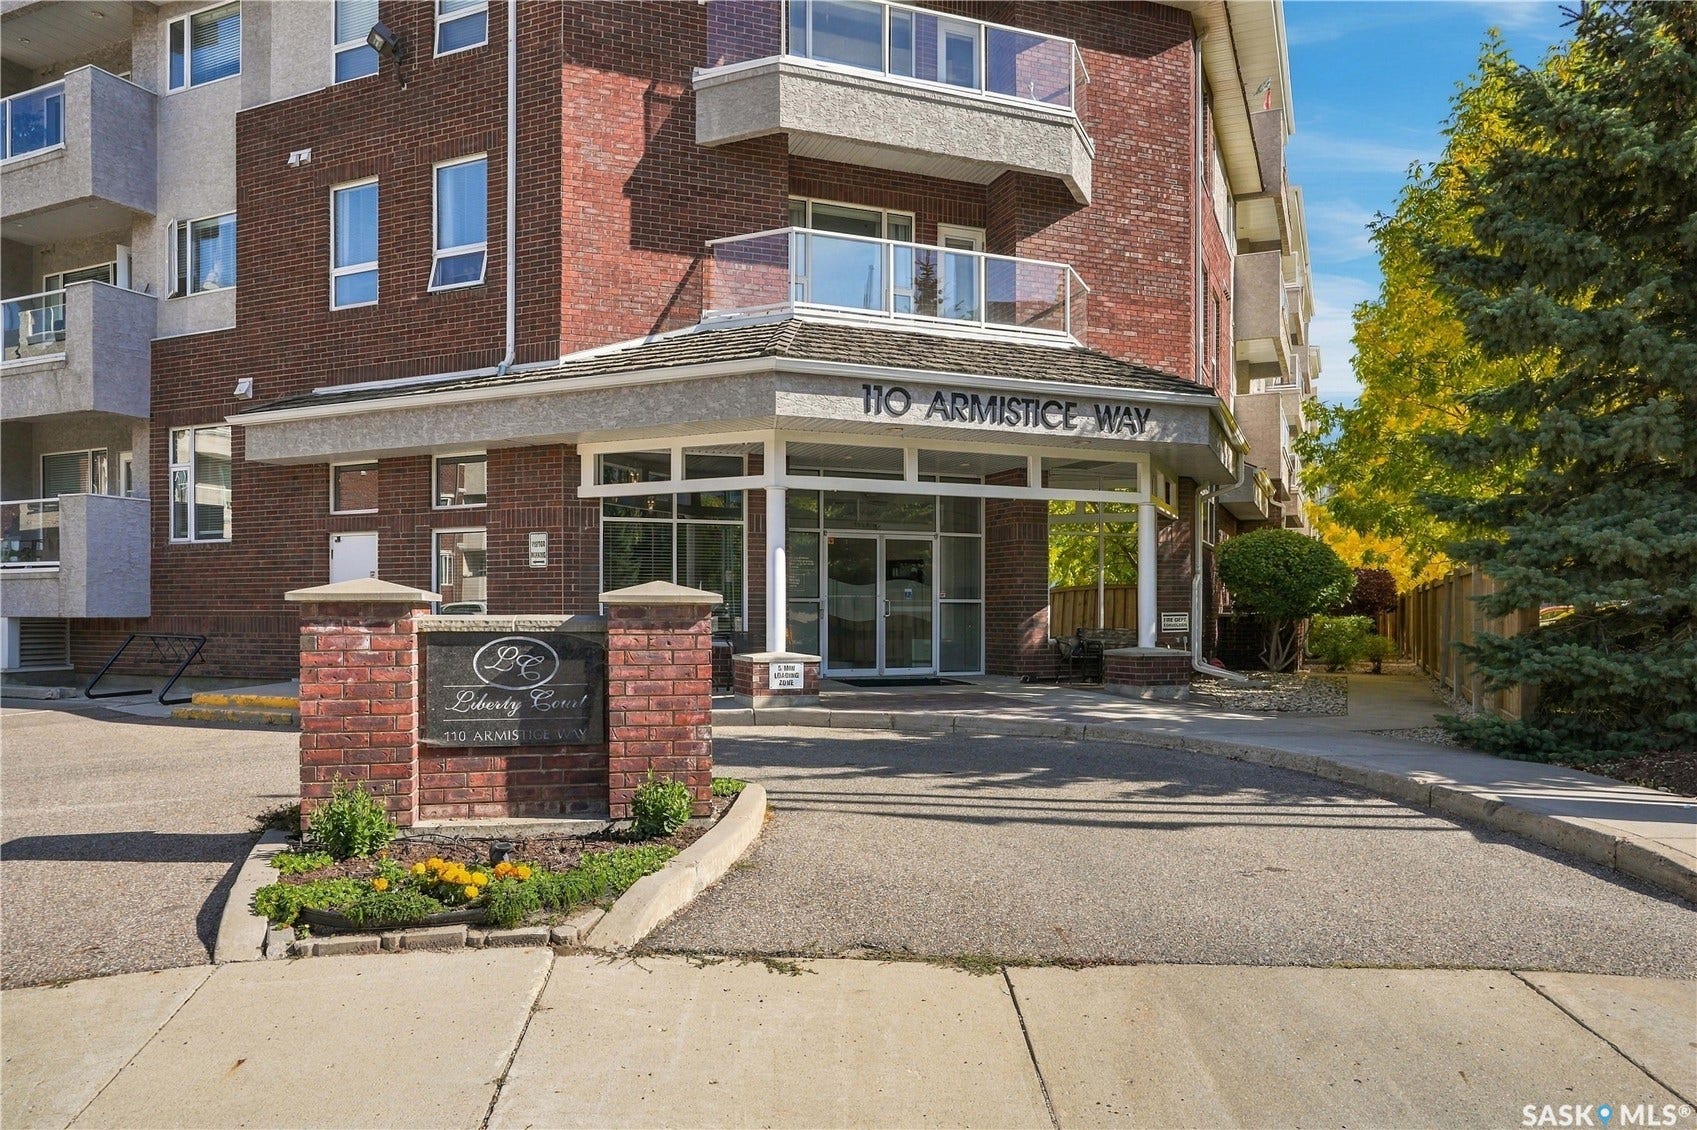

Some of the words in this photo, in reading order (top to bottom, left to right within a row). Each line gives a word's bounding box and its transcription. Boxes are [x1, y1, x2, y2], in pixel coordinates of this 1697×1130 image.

[862, 384, 912, 417] 110
[924, 390, 1077, 430] ARMISTICE
[1094, 403, 1151, 435] WAY
[445, 690, 522, 717] Liberty
[530, 689, 588, 712] Court
[444, 730, 466, 742] 110
[473, 729, 550, 741] ARMISTICE
[557, 728, 587, 740] WAY
